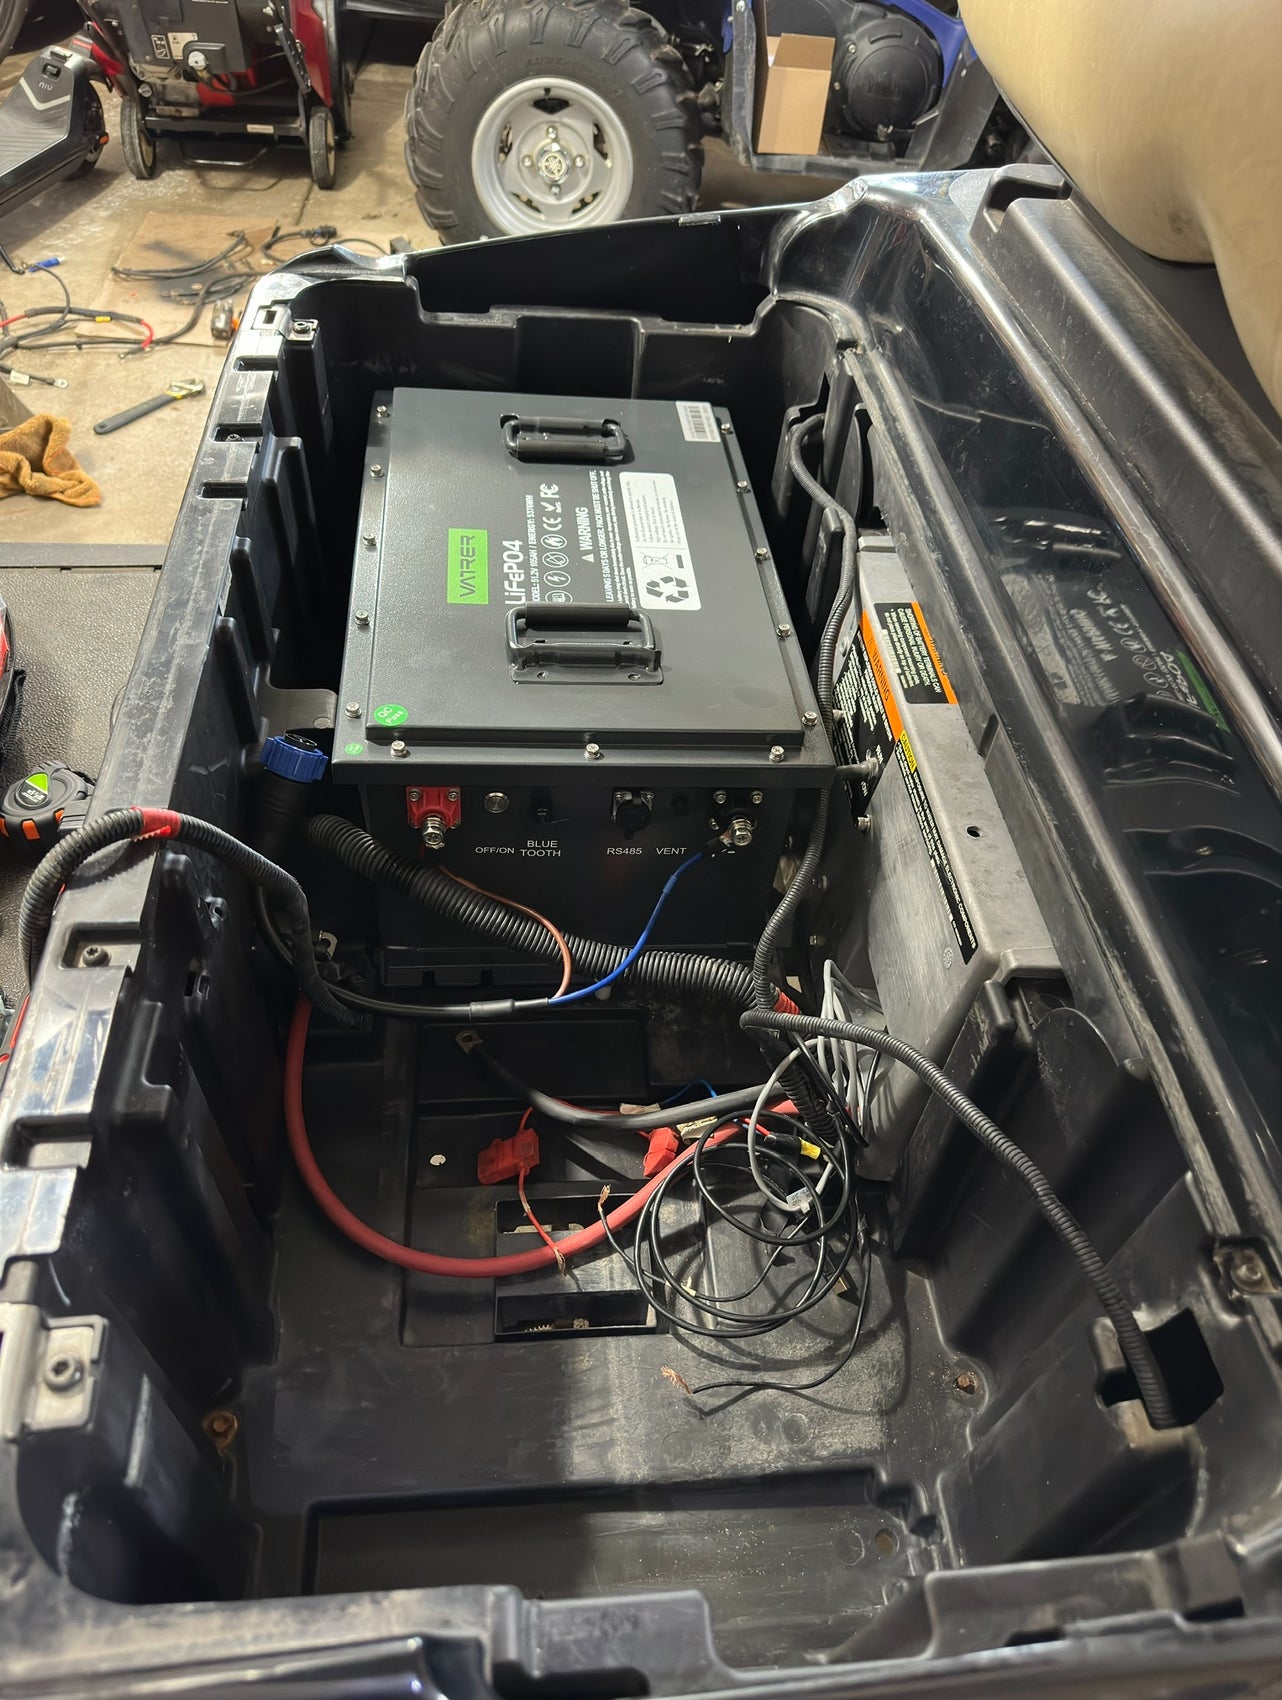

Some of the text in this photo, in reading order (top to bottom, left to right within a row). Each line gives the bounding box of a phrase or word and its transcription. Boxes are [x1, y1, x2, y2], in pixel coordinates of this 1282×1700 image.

[575, 507, 593, 550] WARNING
[460, 535, 476, 597] VATRER
[532, 583, 540, 601] ODEL:
[872, 653, 890, 701] WARNING
[527, 839, 558, 848] BLUE
[475, 846, 515, 854] OFF/ON
[520, 849, 561, 858] TOOTH
[606, 847, 642, 855] RS485
[656, 847, 687, 855] VENT
